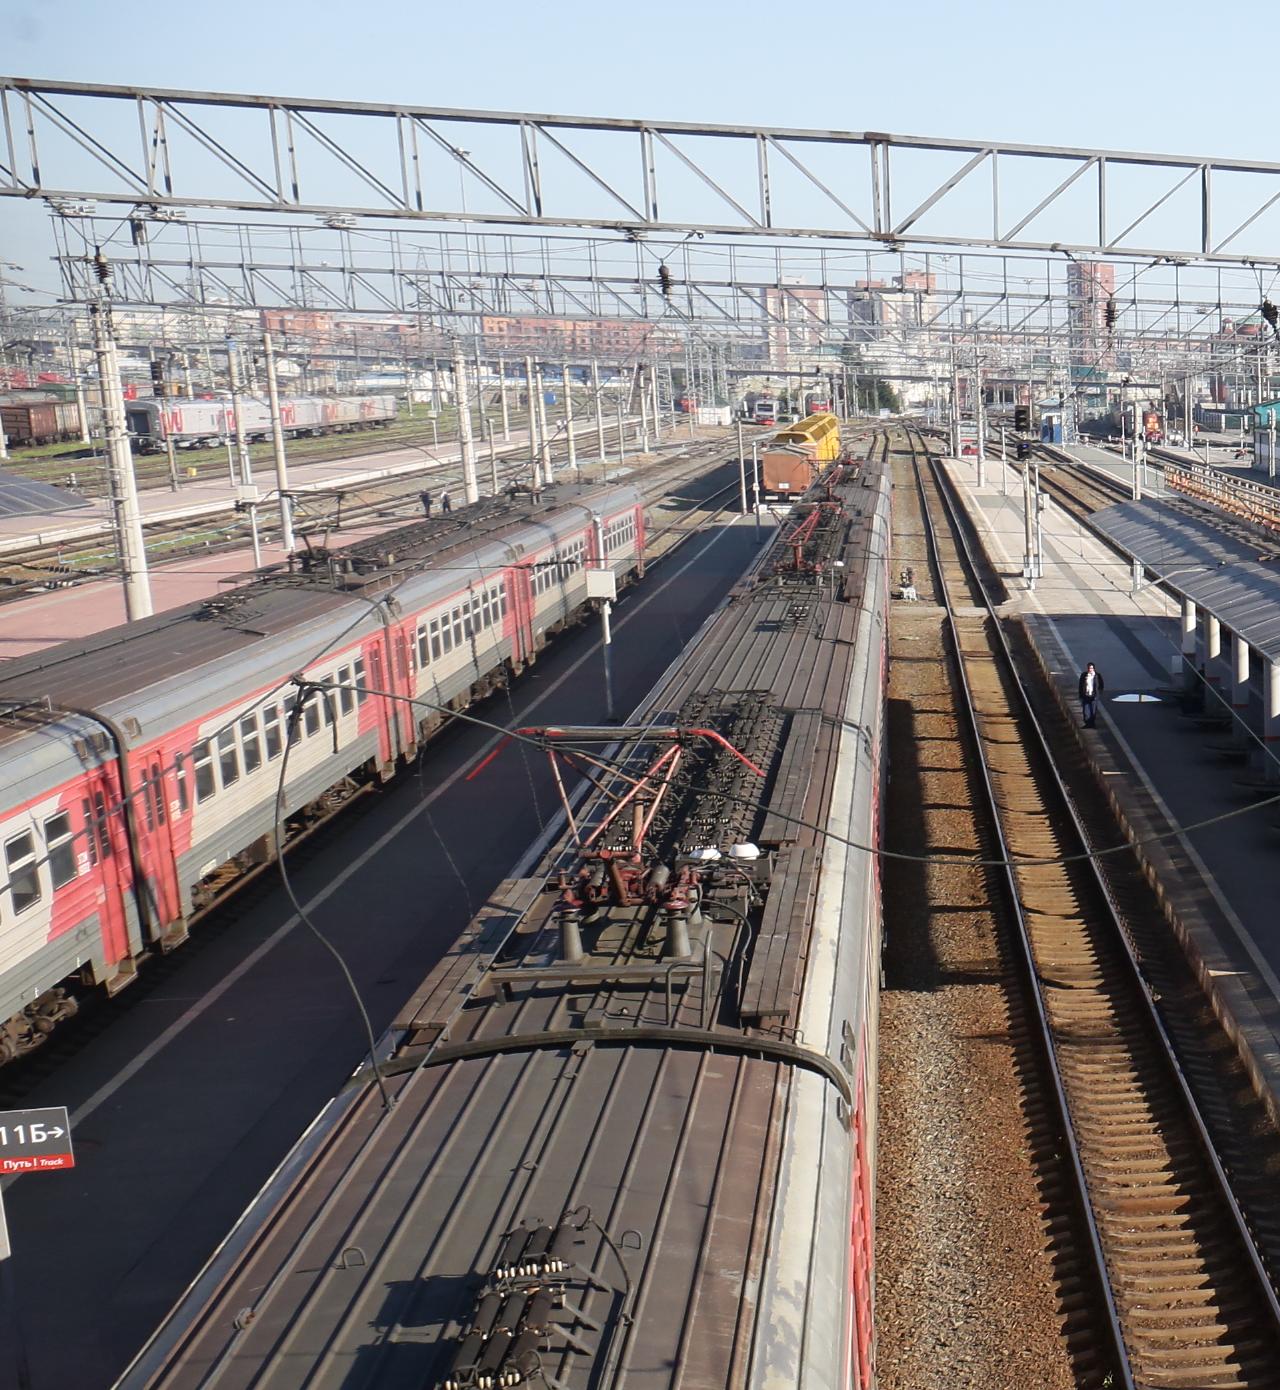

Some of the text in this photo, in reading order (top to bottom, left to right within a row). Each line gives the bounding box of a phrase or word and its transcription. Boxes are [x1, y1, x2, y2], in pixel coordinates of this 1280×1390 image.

[0, 1123, 48, 1146] 11Б
[3, 1158, 64, 1171] Путь Track
